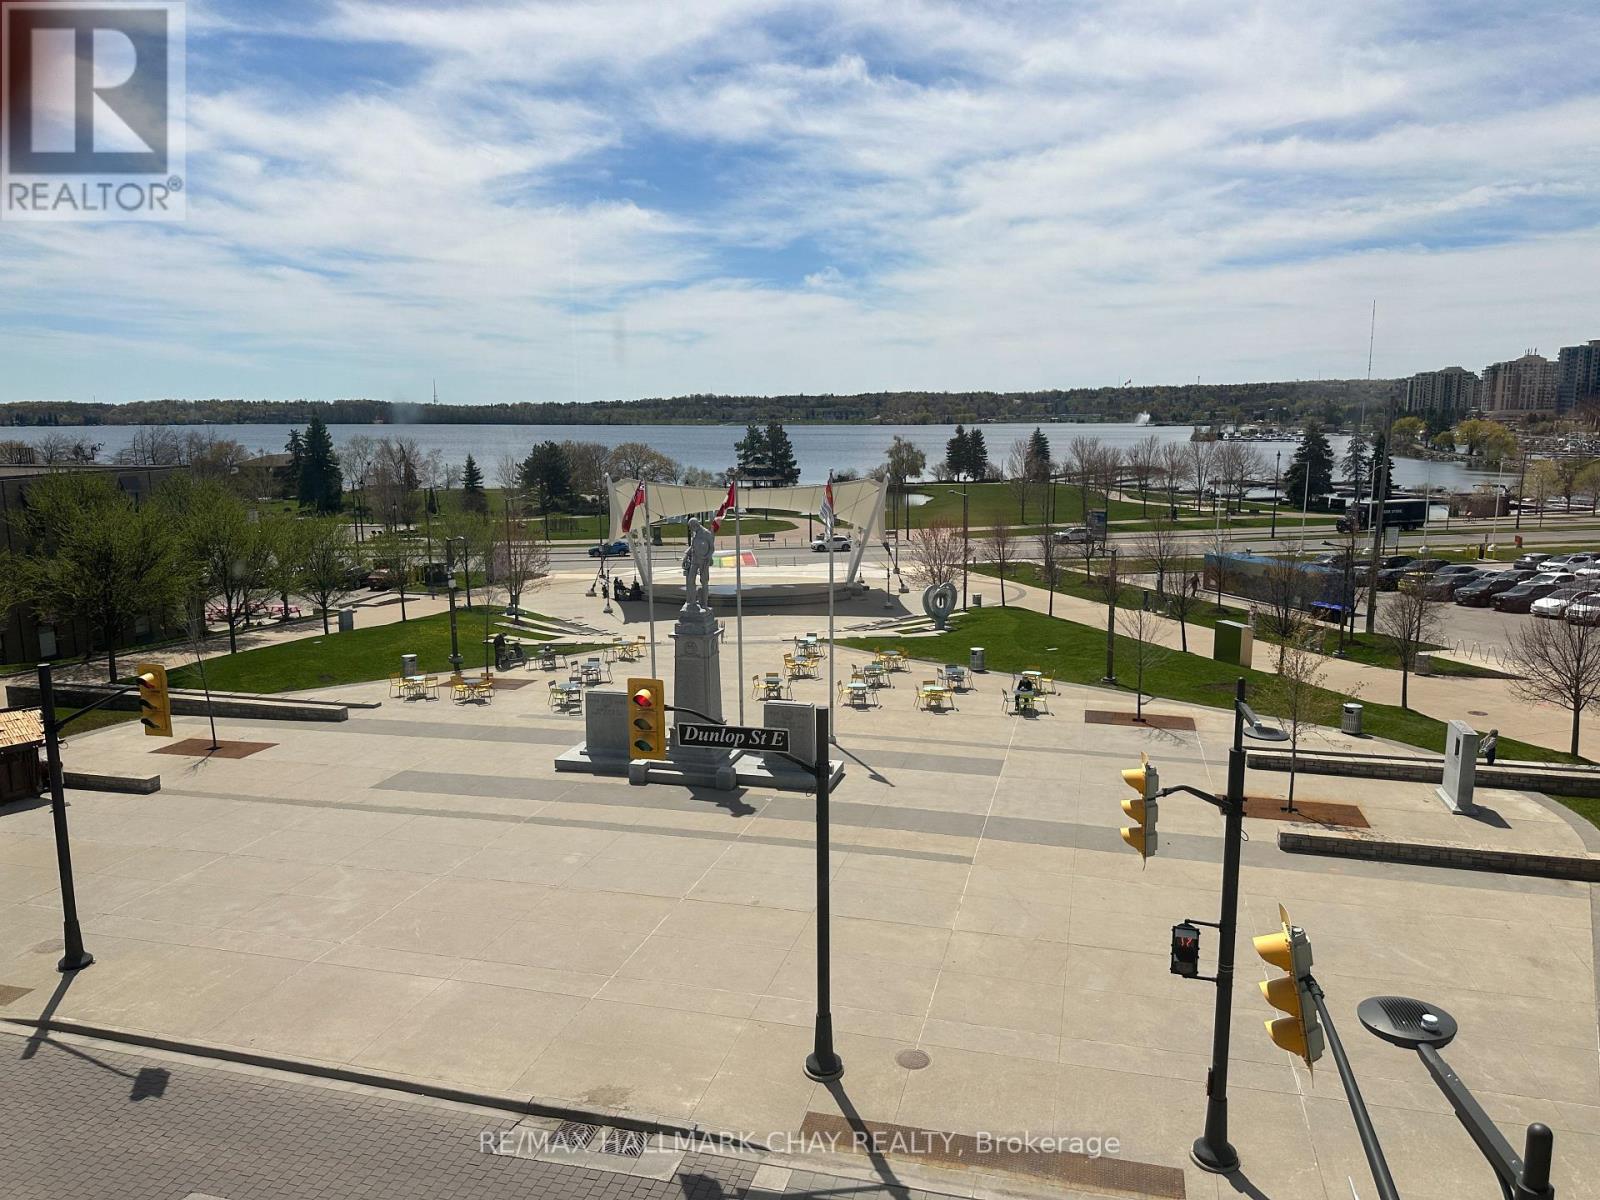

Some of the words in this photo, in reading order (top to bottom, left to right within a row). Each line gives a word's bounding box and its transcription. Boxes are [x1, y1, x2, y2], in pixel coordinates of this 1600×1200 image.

[684, 726, 745, 747] Dunlop
[749, 730, 767, 745] St
[770, 731, 785, 746] E
